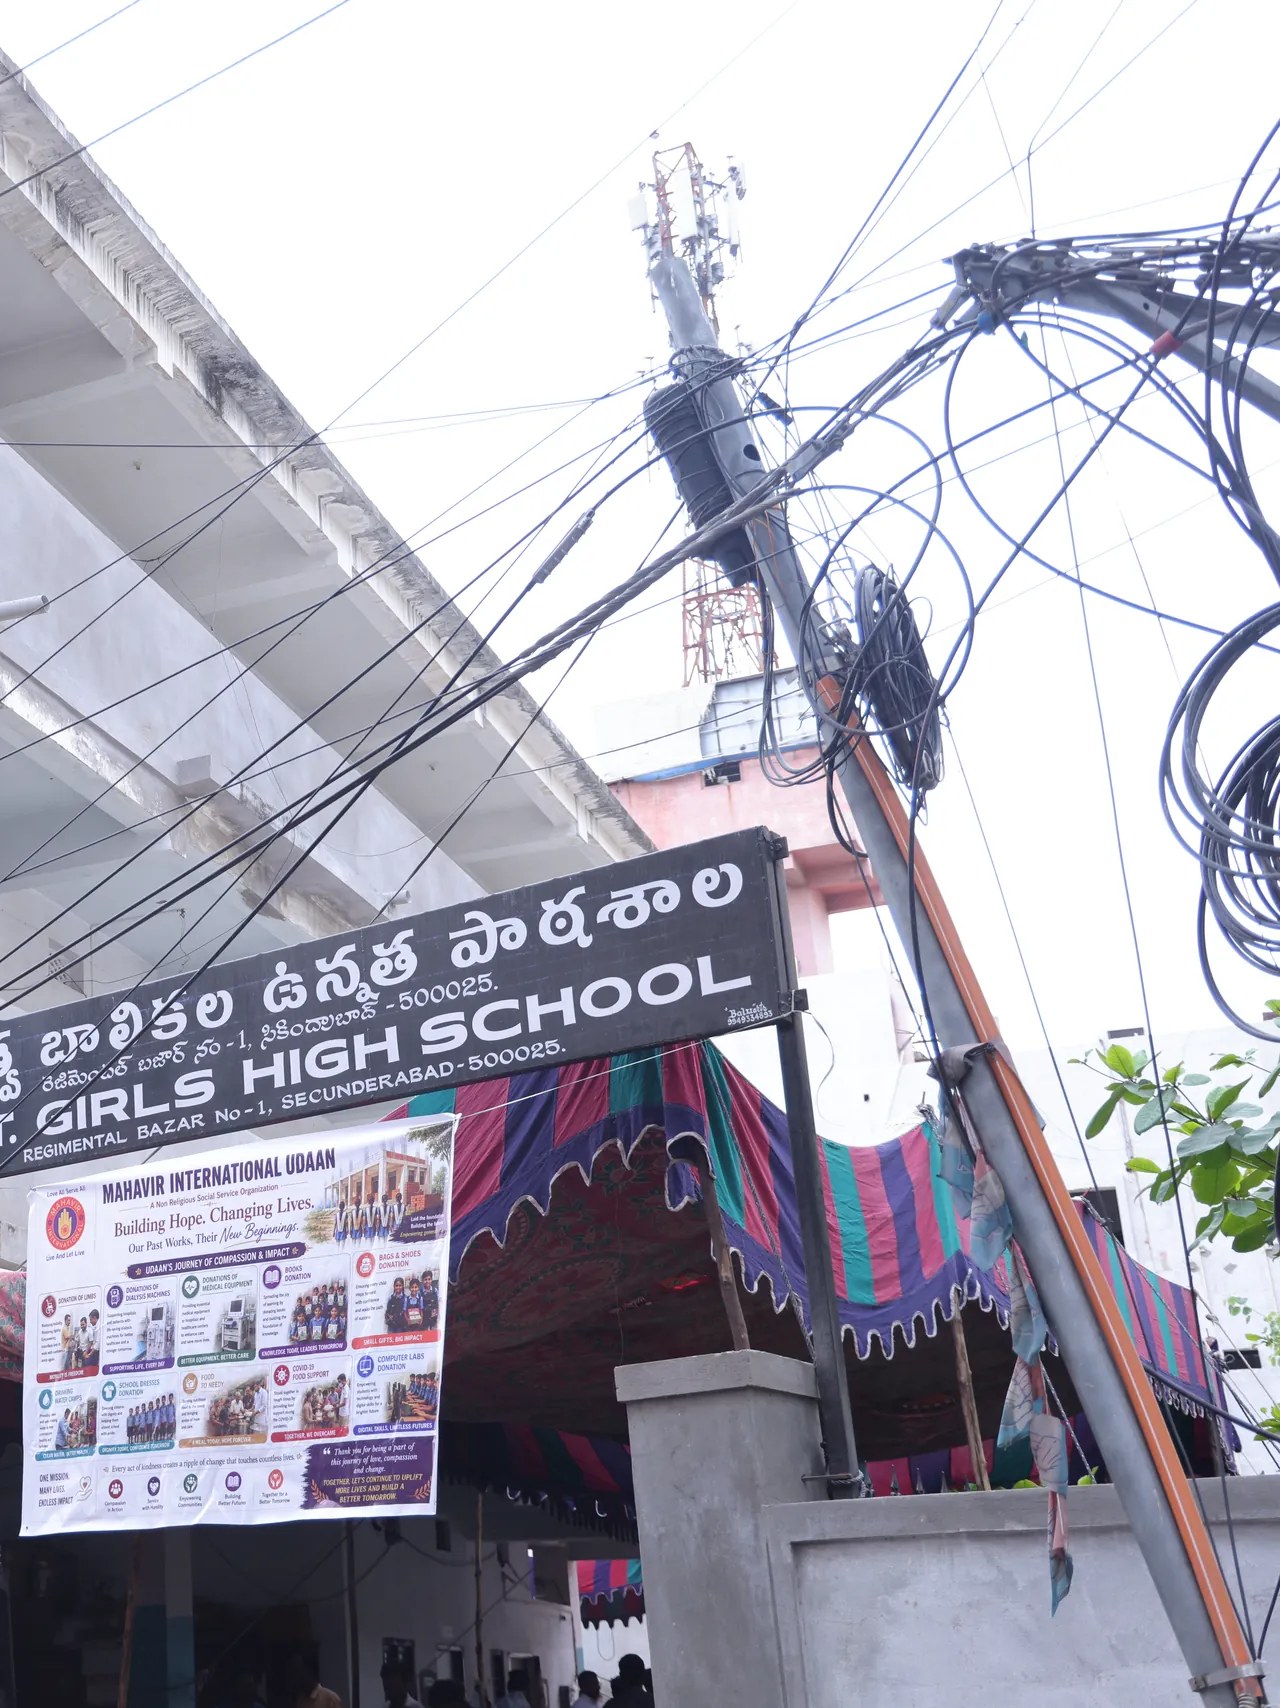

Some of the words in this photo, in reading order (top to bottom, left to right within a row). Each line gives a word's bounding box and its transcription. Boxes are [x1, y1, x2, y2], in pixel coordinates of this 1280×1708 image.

[40, 988, 234, 1067] బాలికల
[36, 1068, 216, 1136] GIRLS
[243, 1025, 400, 1096] HIGH
[420, 955, 752, 1055] SCHOOL
[23, 1129, 128, 1163] REGIMENTAL
[137, 1111, 206, 1139] BAZAR
[102, 1175, 165, 1205] MAHAVIR
[170, 1156, 282, 1194] INTERNATIONAL
[285, 1147, 336, 1175] UDAAN
[156, 1200, 168, 1208] Non
[169, 1195, 196, 1207] Religious
[197, 1193, 215, 1202] Social
[216, 1189, 238, 1199] Service
[240, 1183, 278, 1196] Organization
[114, 1218, 166, 1238] Building
[170, 1212, 206, 1230] Hope.
[210, 1202, 273, 1222] Changing
[277, 1196, 315, 1214] Lives.
[128, 1243, 145, 1253] Our
[146, 1240, 163, 1251] Past
[165, 1235, 193, 1248] Works,
[195, 1232, 218, 1244] Their
[219, 1225, 242, 1244] New
[244, 1222, 299, 1243] Beginnings.
[379, 1252, 395, 1260] BAGS
[401, 1250, 422, 1258] SHOES
[145, 1263, 173, 1274] UDAAN'S
[174, 1259, 203, 1270] JOURNEY
[204, 1257, 213, 1266] OF
[214, 1251, 257, 1265] COMPASSION
[265, 1247, 290, 1259] IMPACT
[378, 1260, 409, 1270] DONATION
[285, 1265, 303, 1273] BOOKS
[202, 1275, 230, 1283] DONATIONS
[285, 1273, 311, 1281] DONATION
[125, 1285, 152, 1293] DONATIONS
[202, 1283, 223, 1291] MEDICAL
[224, 1279, 253, 1289] EQUIPMENT
[147, 1290, 171, 1299] MACHINES
[261, 1348, 286, 1357] KNOWLEDGE
[300, 1345, 318, 1353] LEADERS
[318, 1342, 344, 1351] TOMORROW
[377, 1354, 408, 1363] COMPUTER
[409, 1352, 425, 1360] LABS
[377, 1363, 406, 1371] DONATION
[292, 1372, 306, 1380] FOOD
[307, 1370, 329, 1379] SUPPORT
[412, 1422, 432, 1430] FUTURES
[334, 1448, 352, 1456] Thank
[372, 1444, 387, 1453] being
[392, 1444, 407, 1453] part
[111, 1465, 127, 1473] Every
[141, 1462, 162, 1470] kindness
[183, 1459, 199, 1468] ripple
[206, 1458, 225, 1467] change
[238, 1456, 258, 1464] touches
[259, 1454, 282, 1463] countless
[330, 1458, 341, 1466] this
[341, 1457, 361, 1467] journey
[383, 1453, 418, 1462] compassion
[365, 1465, 386, 1474] change.
[39, 1473, 49, 1482] ONE
[366, 1474, 392, 1484] CONTINUE
[401, 1473, 423, 1481] UPLIFT
[39, 1486, 52, 1495] MANY
[335, 1486, 350, 1494] MORE
[351, 1485, 367, 1493] LIVES
[367, 1484, 381, 1492] AND
[38, 1498, 57, 1507] ENDLESS
[57, 1497, 74, 1505] IMPACT
[339, 1494, 361, 1503] BETTER
